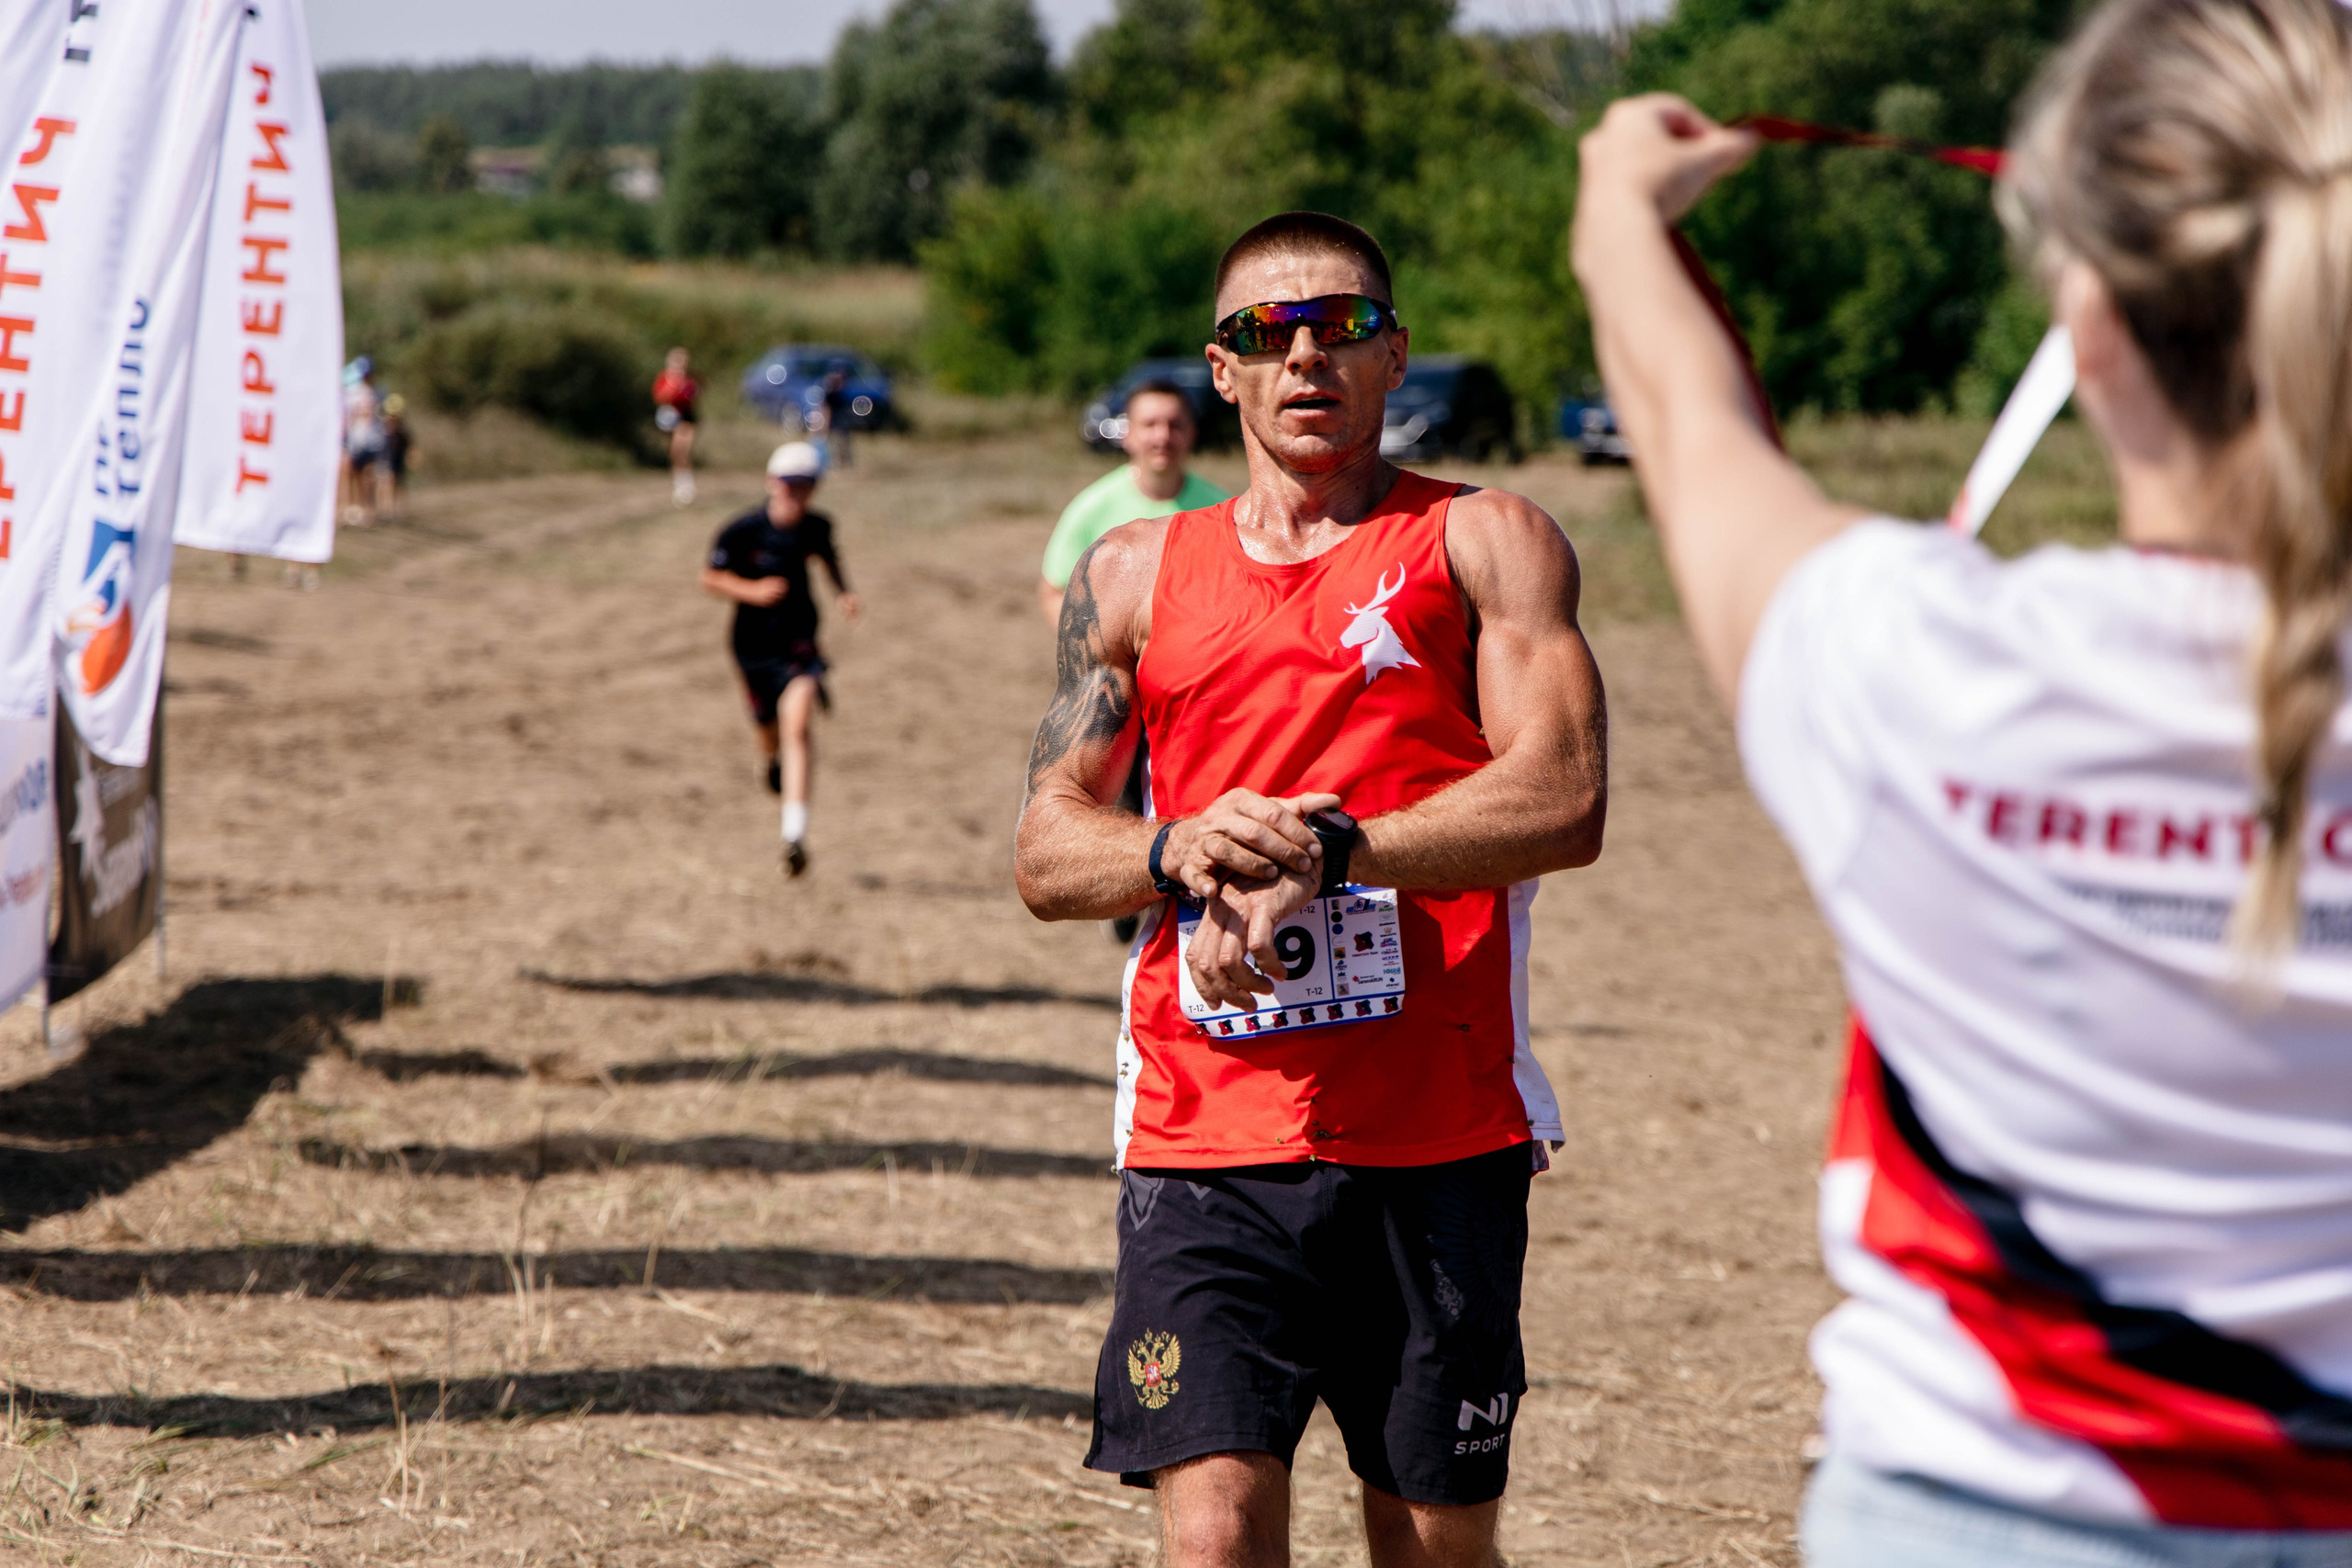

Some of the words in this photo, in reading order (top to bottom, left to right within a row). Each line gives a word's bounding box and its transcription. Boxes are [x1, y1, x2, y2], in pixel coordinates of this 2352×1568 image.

[0, 117, 77, 558] ЕНТИЧ
[1254, 925, 1316, 981] 9
[1306, 987, 1323, 996] T-12
[1188, 1004, 1204, 1013] T-12
[1454, 1433, 1505, 1455] SPORT
